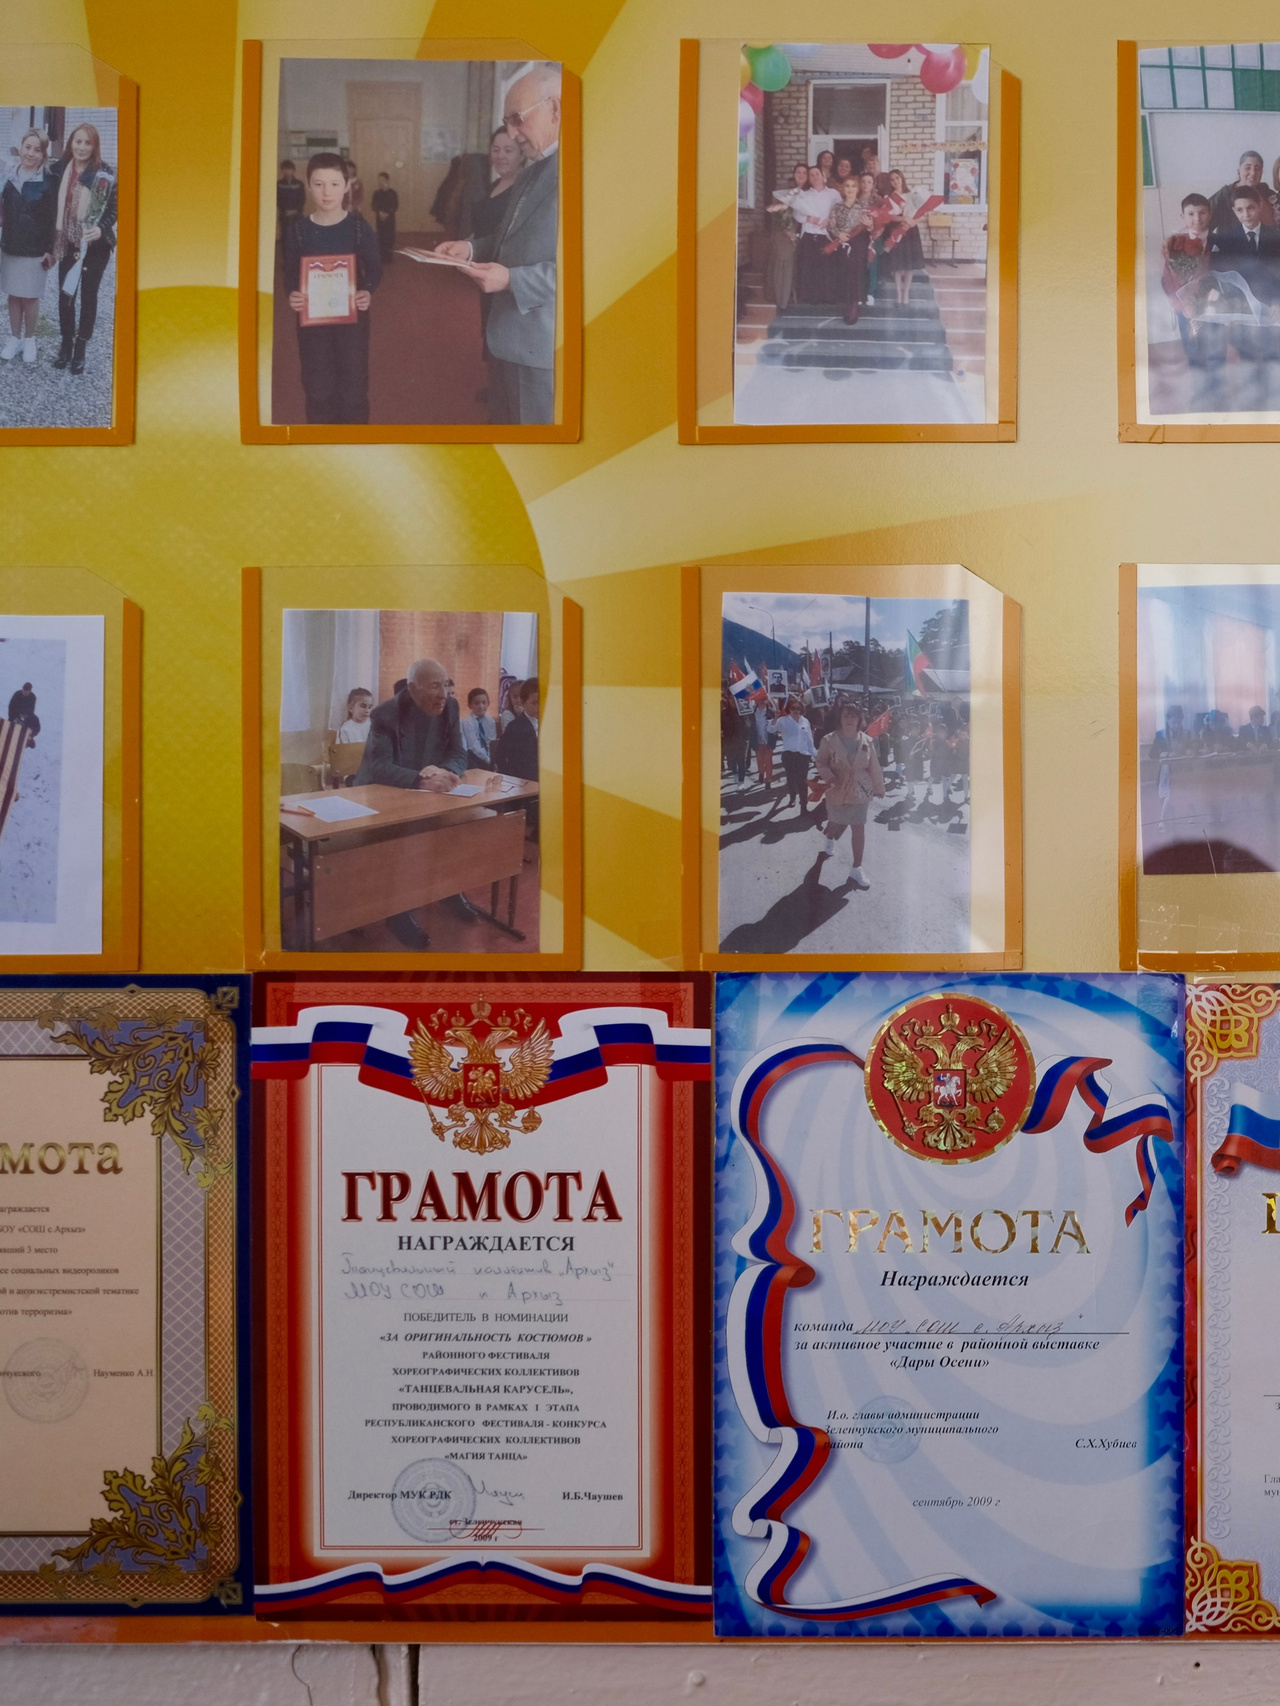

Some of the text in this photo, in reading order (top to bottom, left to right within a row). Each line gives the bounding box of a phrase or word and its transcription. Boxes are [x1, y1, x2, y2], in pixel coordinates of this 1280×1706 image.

[341, 1169, 623, 1223] ГРАМОТА
[808, 1208, 1092, 1255] ГРАМОТА
[397, 1235, 575, 1253] НАГРАЖДАЕТСЯ
[62, 1268, 120, 1276] видеороликов
[880, 1269, 1030, 1292] Награждается
[16, 1287, 100, 1297] антиэкстремистской
[21, 1309, 72, 1318] терроризма»
[404, 1312, 568, 1324] ПОБЕДИТЕЛЬ НОМИНАЦИИ
[793, 1321, 854, 1332] команда
[380, 1332, 584, 1343] «ЗА ОРИГИНАЛЬНОСТЬ КОСТЮМОВ
[812, 1338, 1100, 1353] активное участие районной выставке
[422, 1350, 550, 1360] РАЙОННОГО ФЕСТИВАЛЯ
[890, 1356, 989, 1371] «Дары Осени»
[93, 1369, 155, 1379] Науменко А.Н.
[393, 1367, 580, 1377] ХОРЕОГРАФИЧЕСКИХ КОЛЛЕКТИВОВ
[399, 1384, 573, 1395] «ТАНЦЕВАЛЬНАЯ КАРУСЕЛЬ»,
[392, 1403, 579, 1412] ПРОВОДИМОГО РАМКАХ ЭТАПА
[827, 1410, 980, 1422] И.о. главы администрации
[365, 1419, 607, 1428] РЕСПУБЛИКАНСКОГО ФЕСТИВАЛЯ КОНКУРСА
[822, 1423, 999, 1437] Зеленчукского муниципального
[392, 1435, 581, 1445] ХОРЕОГРАФИЧЕСКИХ КОЛЛЕКТИВОВ
[1074, 1438, 1138, 1451] С.Х.Хубиев
[444, 1452, 528, 1461] «МАГИЯ ТАНЦА»
[348, 1489, 624, 1502] Директор МУК РДК И.Б.Чаушев
[912, 1496, 993, 1509] сентябрь 2009
